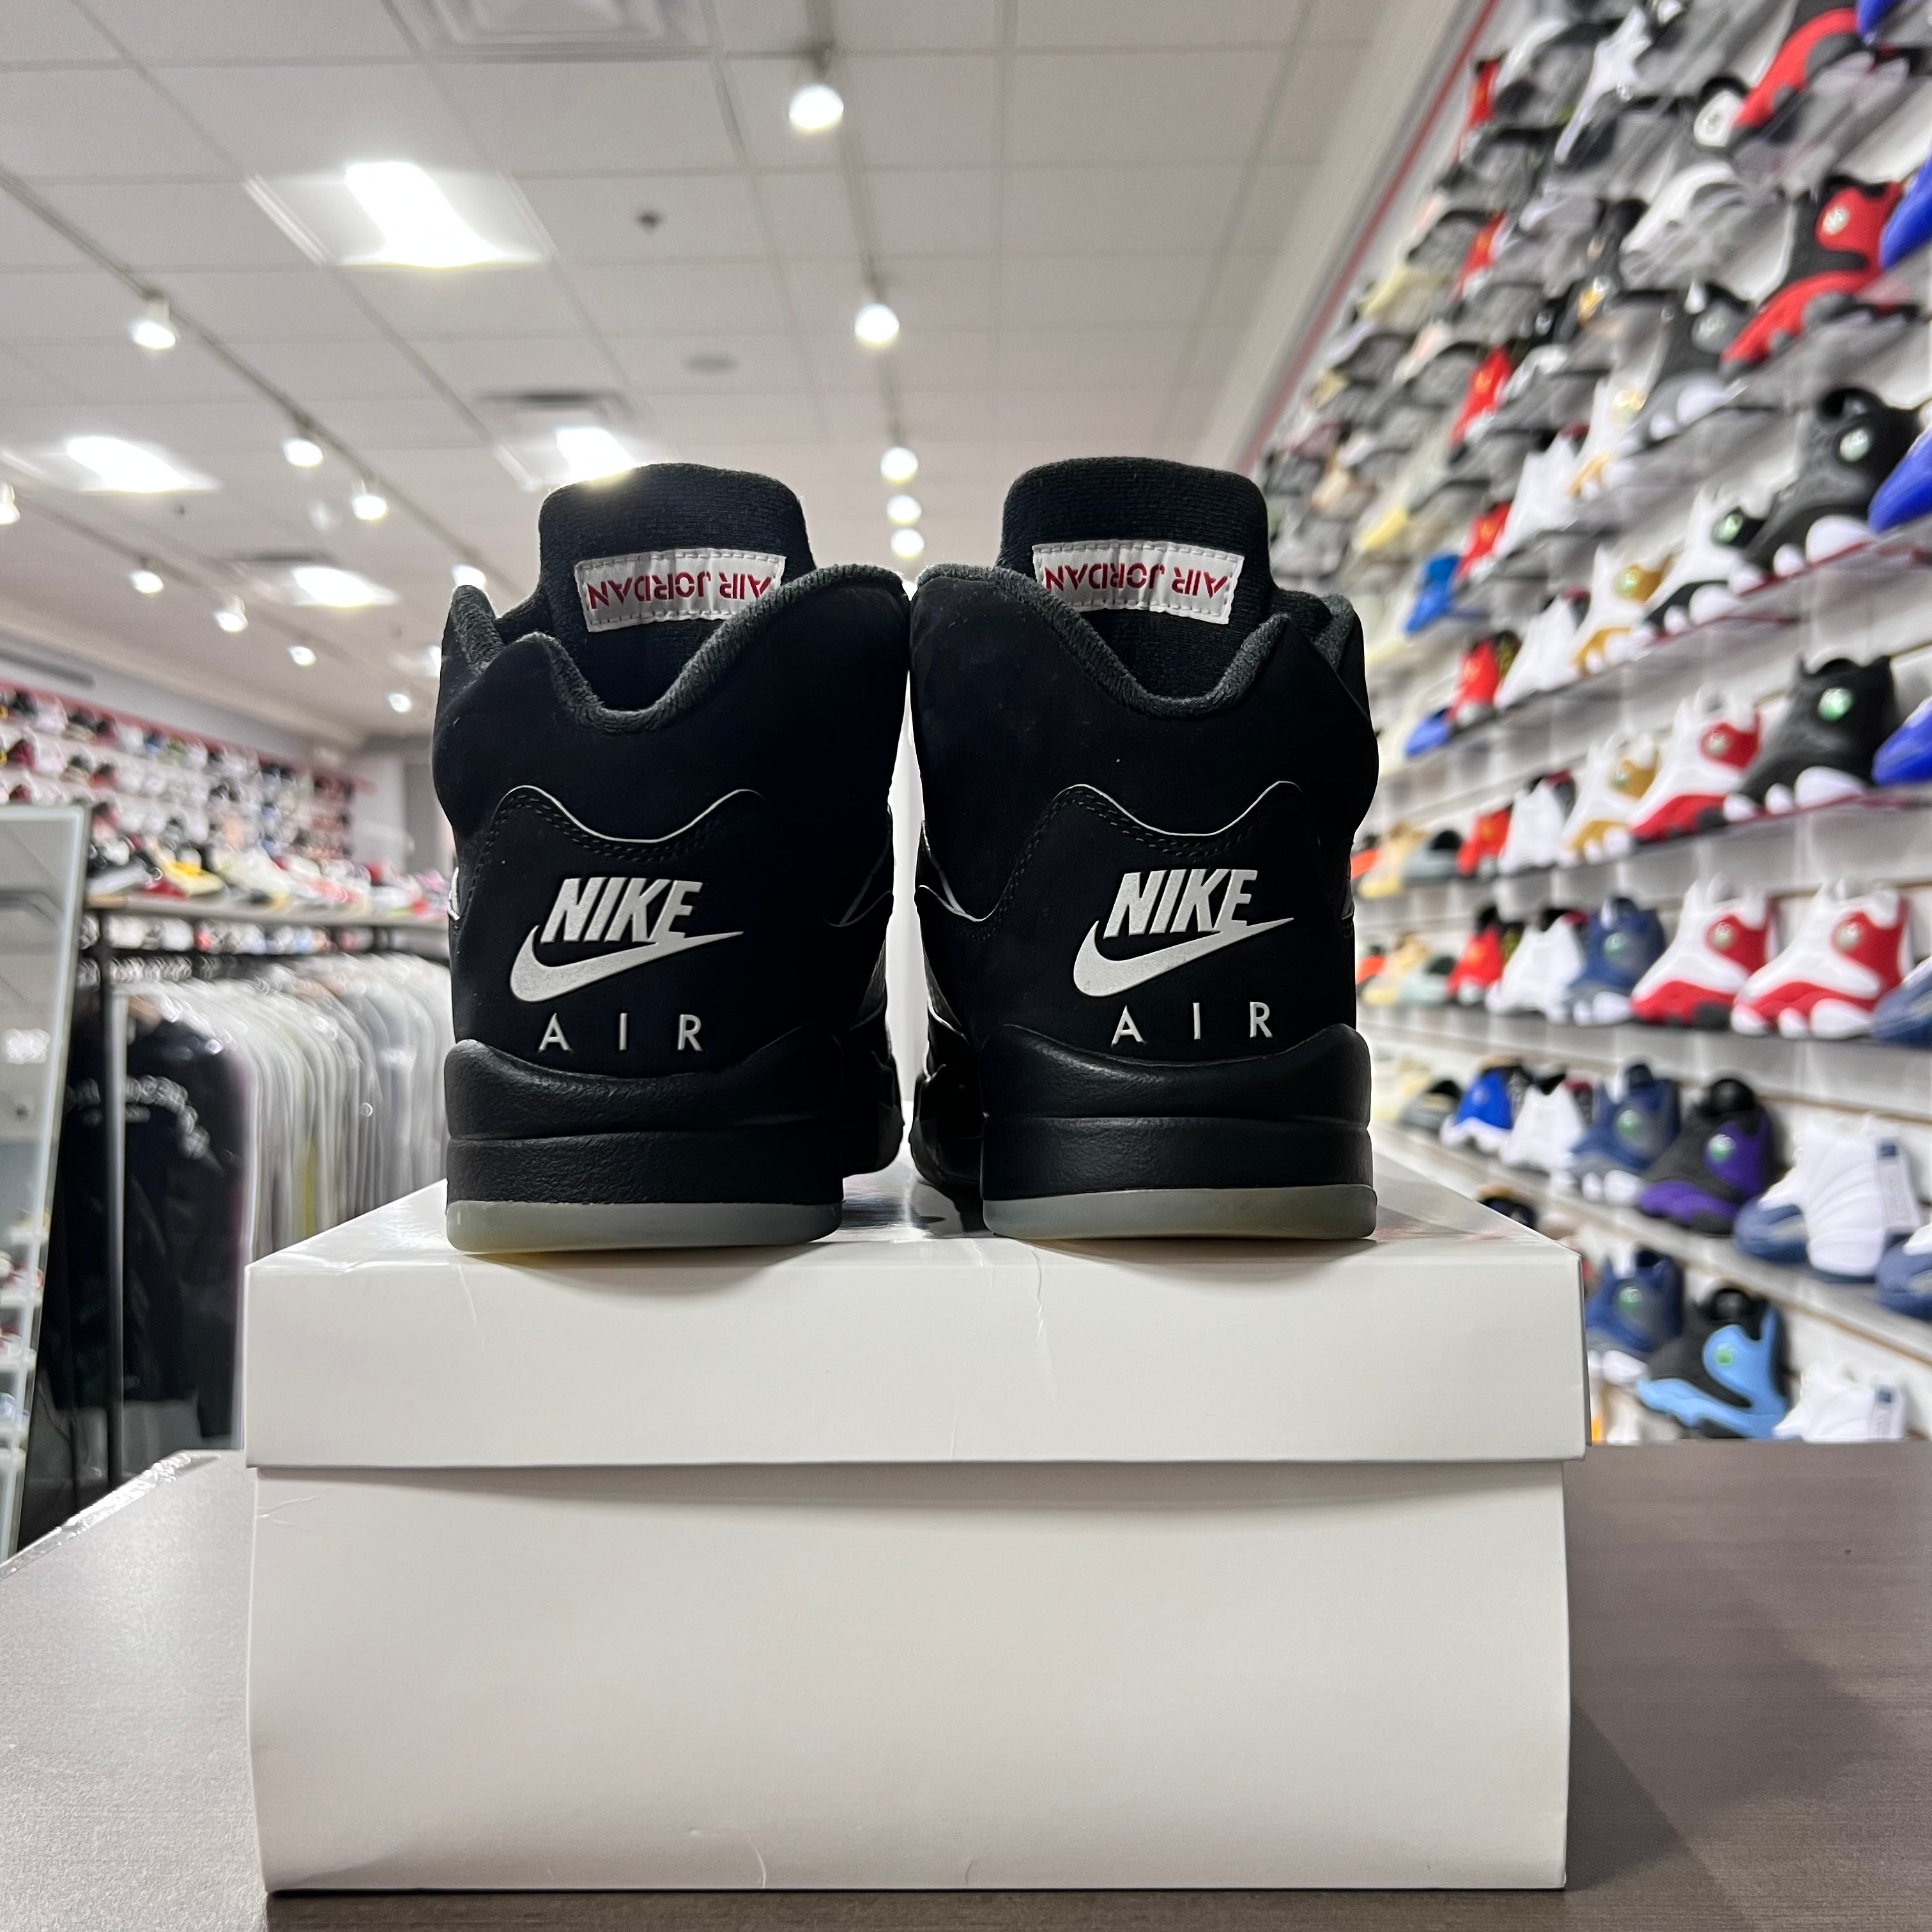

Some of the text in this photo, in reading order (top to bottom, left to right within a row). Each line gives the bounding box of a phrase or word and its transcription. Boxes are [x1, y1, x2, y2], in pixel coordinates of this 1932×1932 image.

[587, 571, 772, 610] AIR JORDAN
[1044, 562, 1228, 599] AIR JORDAN
[540, 877, 703, 944] NIKE
[1103, 868, 1258, 940] NIKE
[537, 1012, 703, 1052] AIR
[1110, 1001, 1273, 1048] AIR
